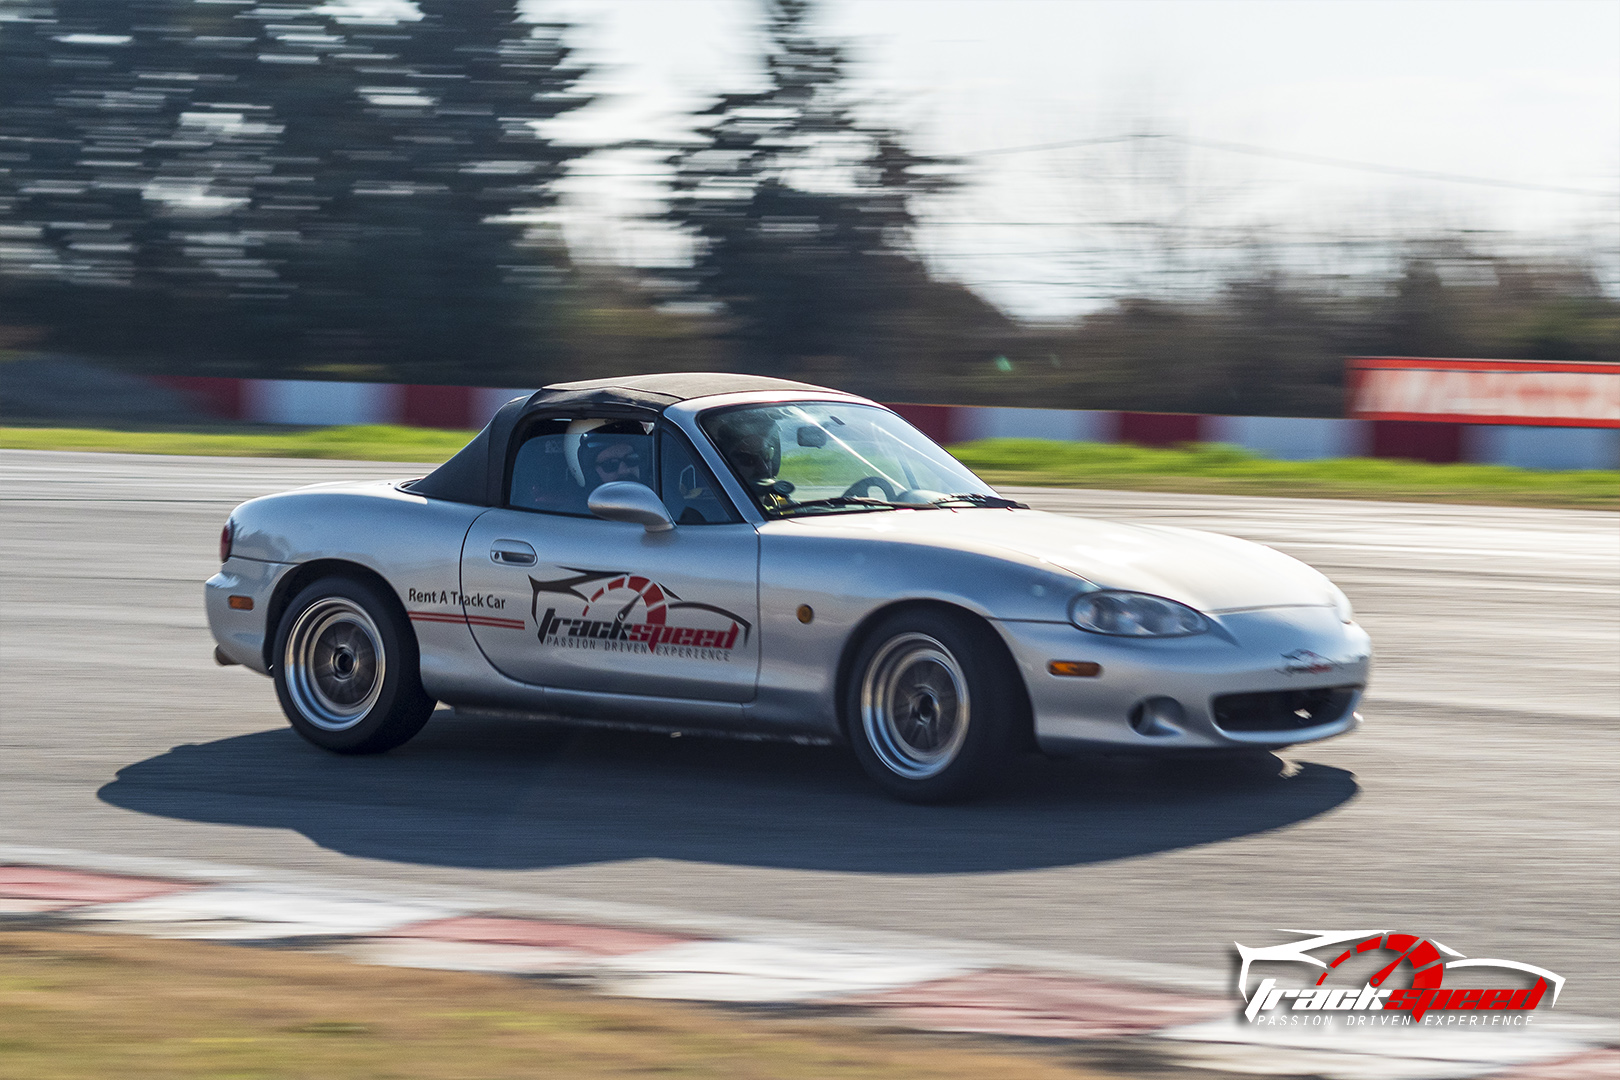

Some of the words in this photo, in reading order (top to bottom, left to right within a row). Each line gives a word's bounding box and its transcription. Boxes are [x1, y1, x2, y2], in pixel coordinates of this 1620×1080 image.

[408, 588, 437, 603] Rent
[440, 590, 448, 605] A
[450, 591, 484, 608] Track
[486, 594, 506, 610] Car
[546, 636, 596, 650] PASSION
[604, 639, 648, 655] DRIVEN
[655, 643, 731, 662] EXPERIENCE
